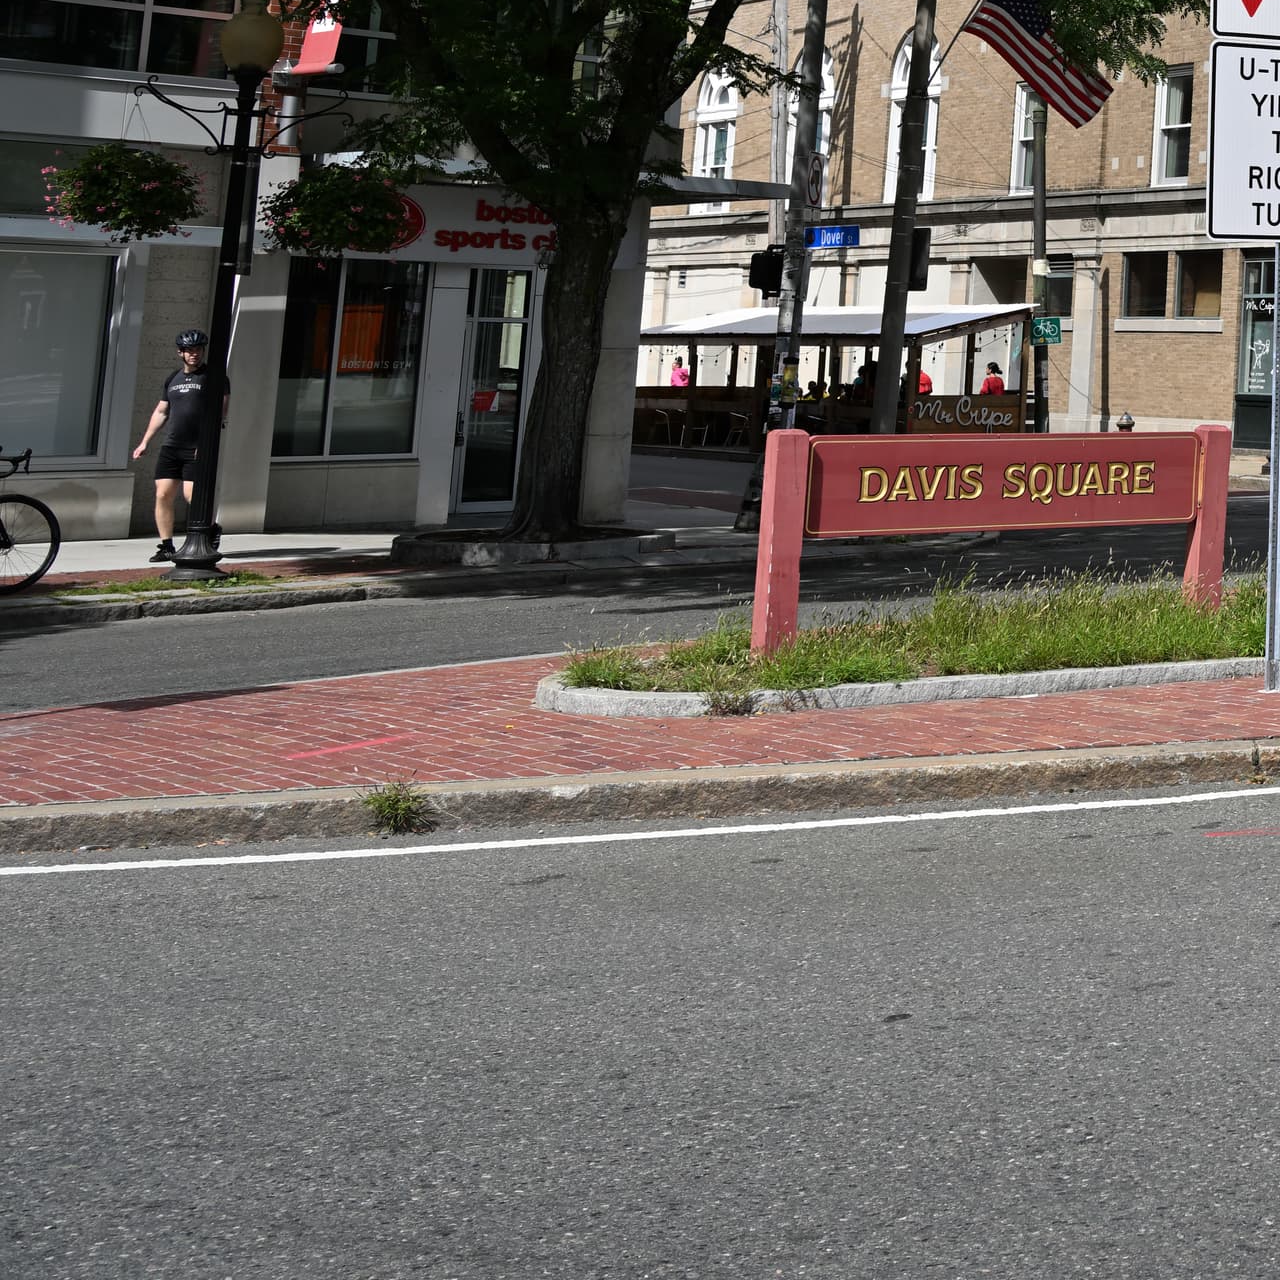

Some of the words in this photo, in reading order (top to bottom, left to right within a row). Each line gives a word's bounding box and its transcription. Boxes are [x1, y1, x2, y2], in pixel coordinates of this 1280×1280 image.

[476, 198, 553, 225] bosto
[434, 227, 528, 253] sports
[821, 229, 844, 246] Dover
[341, 359, 390, 370] BOSTON'S
[392, 360, 413, 369] GYM
[857, 463, 984, 503] DAVIS
[1001, 461, 1156, 505] SQUARE
